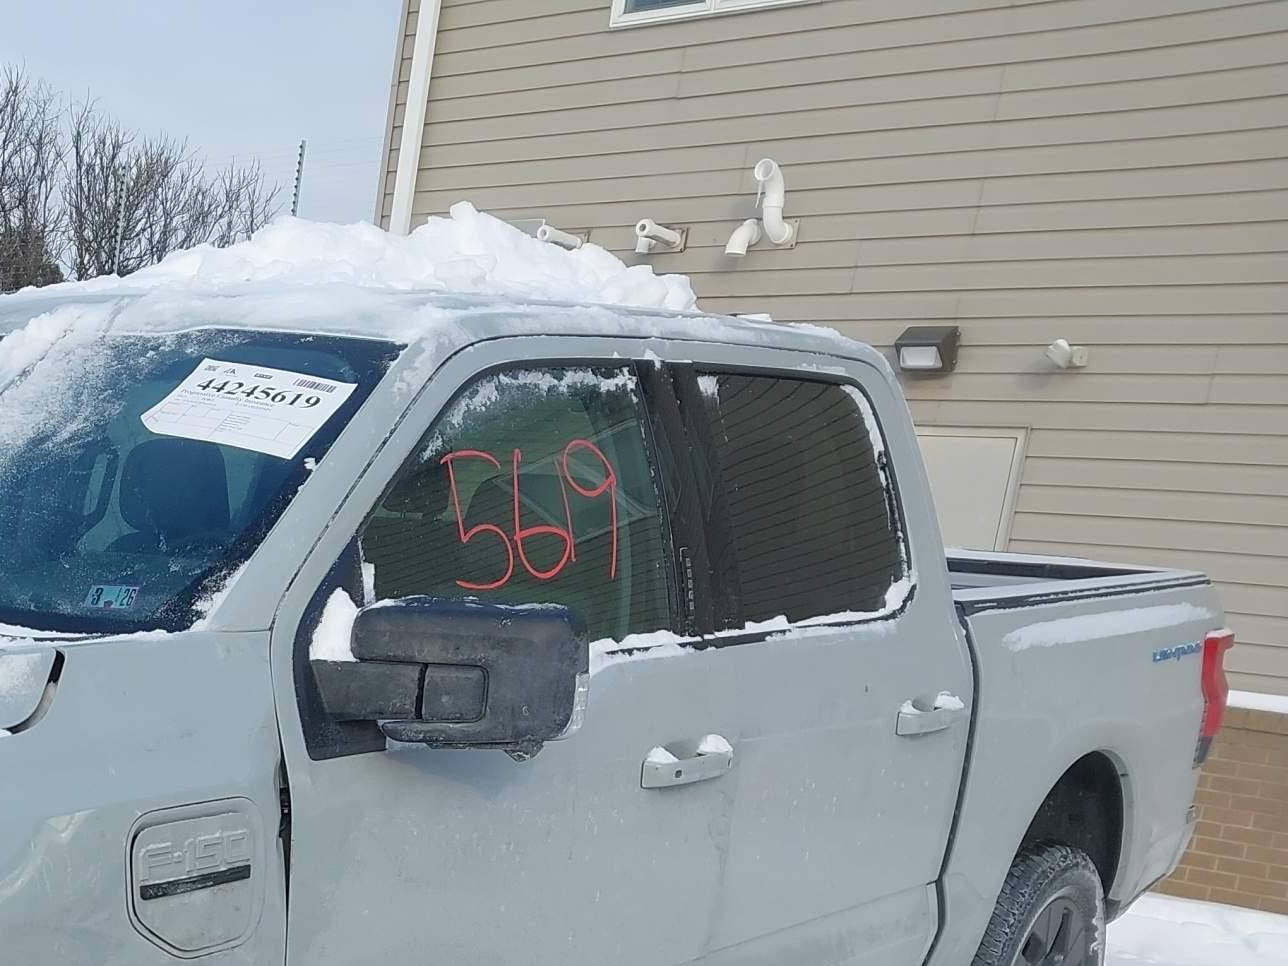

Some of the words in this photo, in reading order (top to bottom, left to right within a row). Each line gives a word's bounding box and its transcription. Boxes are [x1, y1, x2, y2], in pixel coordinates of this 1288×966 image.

[195, 377, 322, 409] 44245619
[440, 438, 617, 591] 5619
[90, 587, 105, 606] 3
[139, 829, 252, 882] F-150
